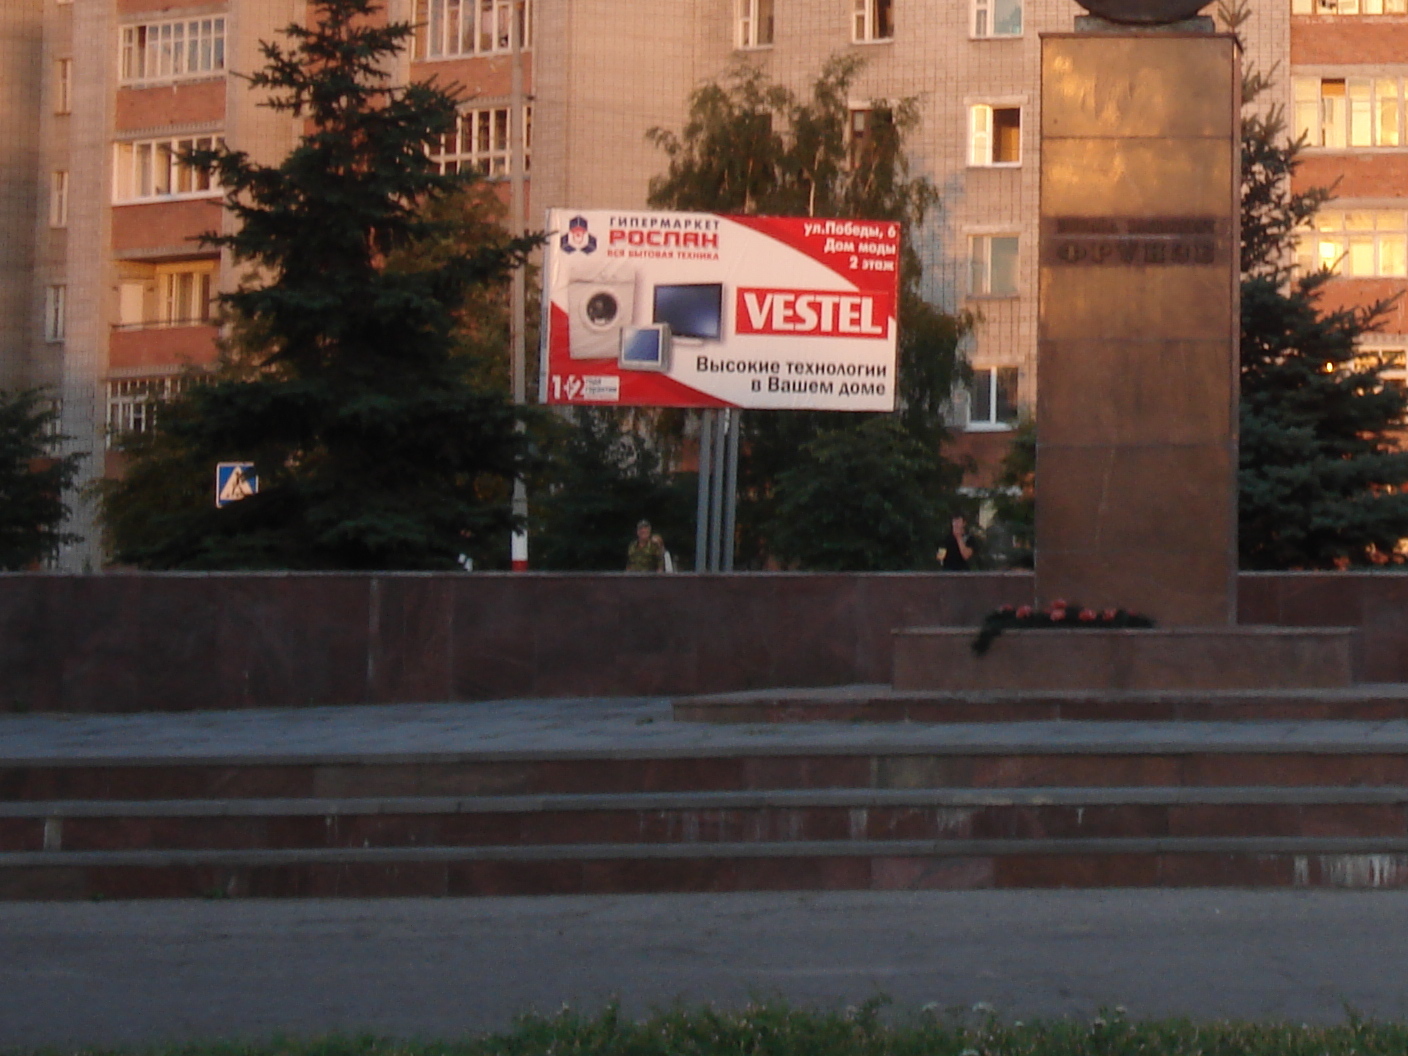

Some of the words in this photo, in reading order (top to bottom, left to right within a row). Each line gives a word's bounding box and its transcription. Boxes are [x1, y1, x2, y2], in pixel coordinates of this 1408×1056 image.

[609, 216, 719, 230] ГИПЕРМАРКЕТ
[887, 225, 896, 238] 6
[607, 249, 625, 257] ВСЯ
[628, 250, 674, 259] БЫТОВАЯ
[677, 251, 719, 261] ТЕХНИКА
[824, 237, 855, 254] Дом
[858, 242, 896, 256] моды
[849, 255, 858, 269] 2
[862, 259, 894, 271] этаж
[743, 292, 883, 334] VESTEL
[696, 355, 780, 374] Высокие
[787, 361, 887, 377] технологии
[751, 379, 761, 393] в
[768, 376, 833, 394] Вашем
[838, 382, 886, 397] доме
